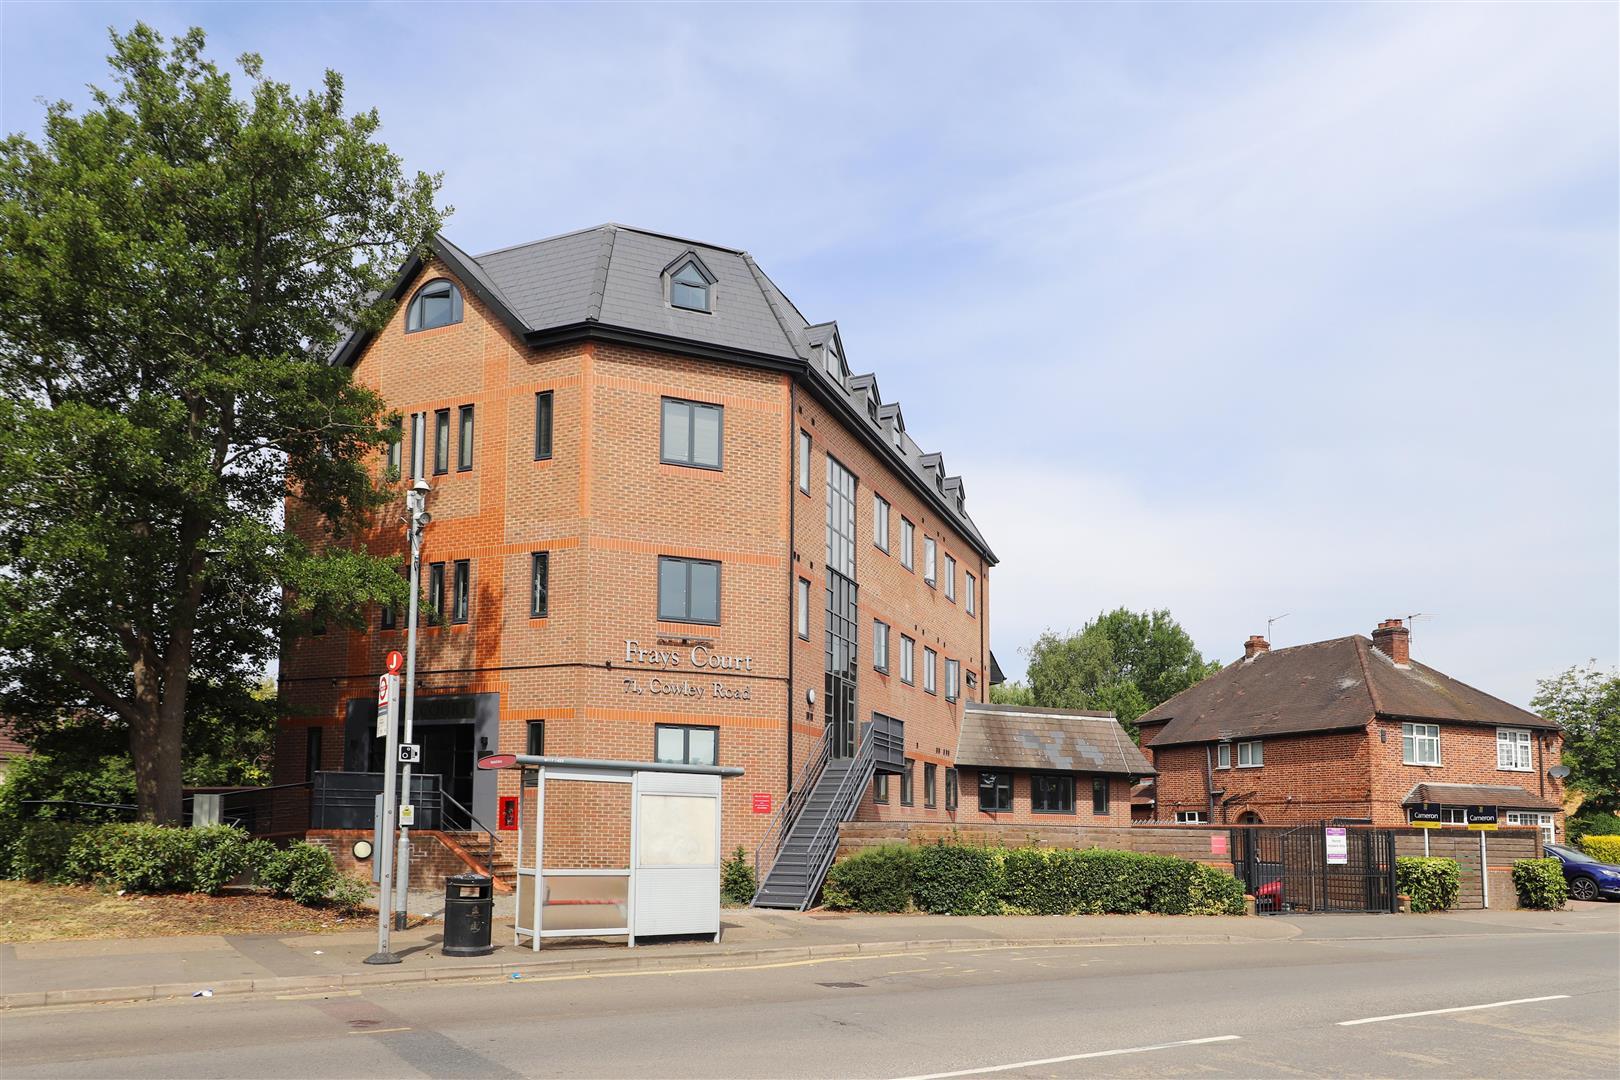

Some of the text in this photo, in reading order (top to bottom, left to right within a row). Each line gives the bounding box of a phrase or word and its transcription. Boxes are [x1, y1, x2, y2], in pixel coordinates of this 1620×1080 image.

[389, 653, 397, 669] J
[624, 640, 752, 671] Frays Court
[623, 678, 751, 700] 71, Cowley Road
